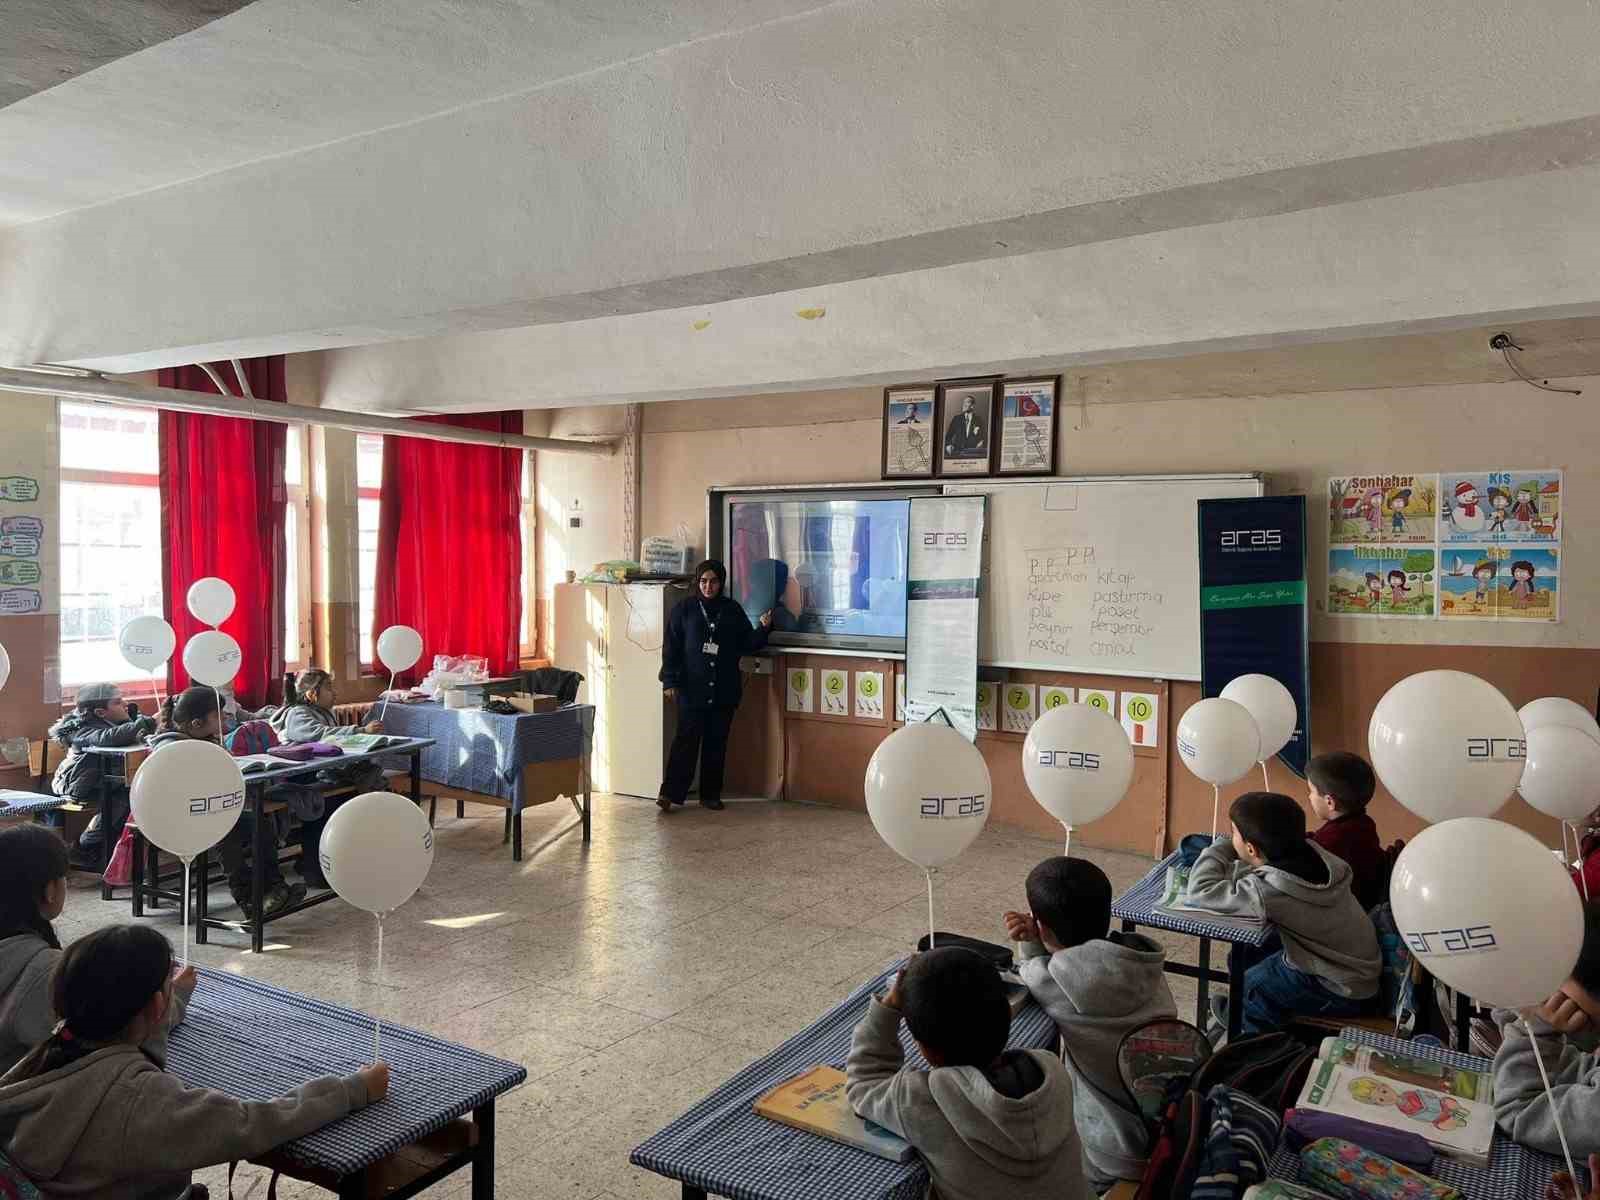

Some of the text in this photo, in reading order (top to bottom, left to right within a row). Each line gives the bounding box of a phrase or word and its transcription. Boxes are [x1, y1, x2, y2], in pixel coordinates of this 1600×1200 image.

[923, 532, 968, 545] aras
[1221, 529, 1281, 546] aras
[831, 677, 839, 690] 2
[865, 679, 873, 693] 3
[1014, 691, 1023, 705] 7
[1051, 695, 1061, 708] 8
[1131, 702, 1147, 717] 10
[1039, 750, 1100, 769] aras
[190, 790, 243, 816] aras
[920, 794, 985, 816] aras
[1406, 925, 1496, 953] aras
